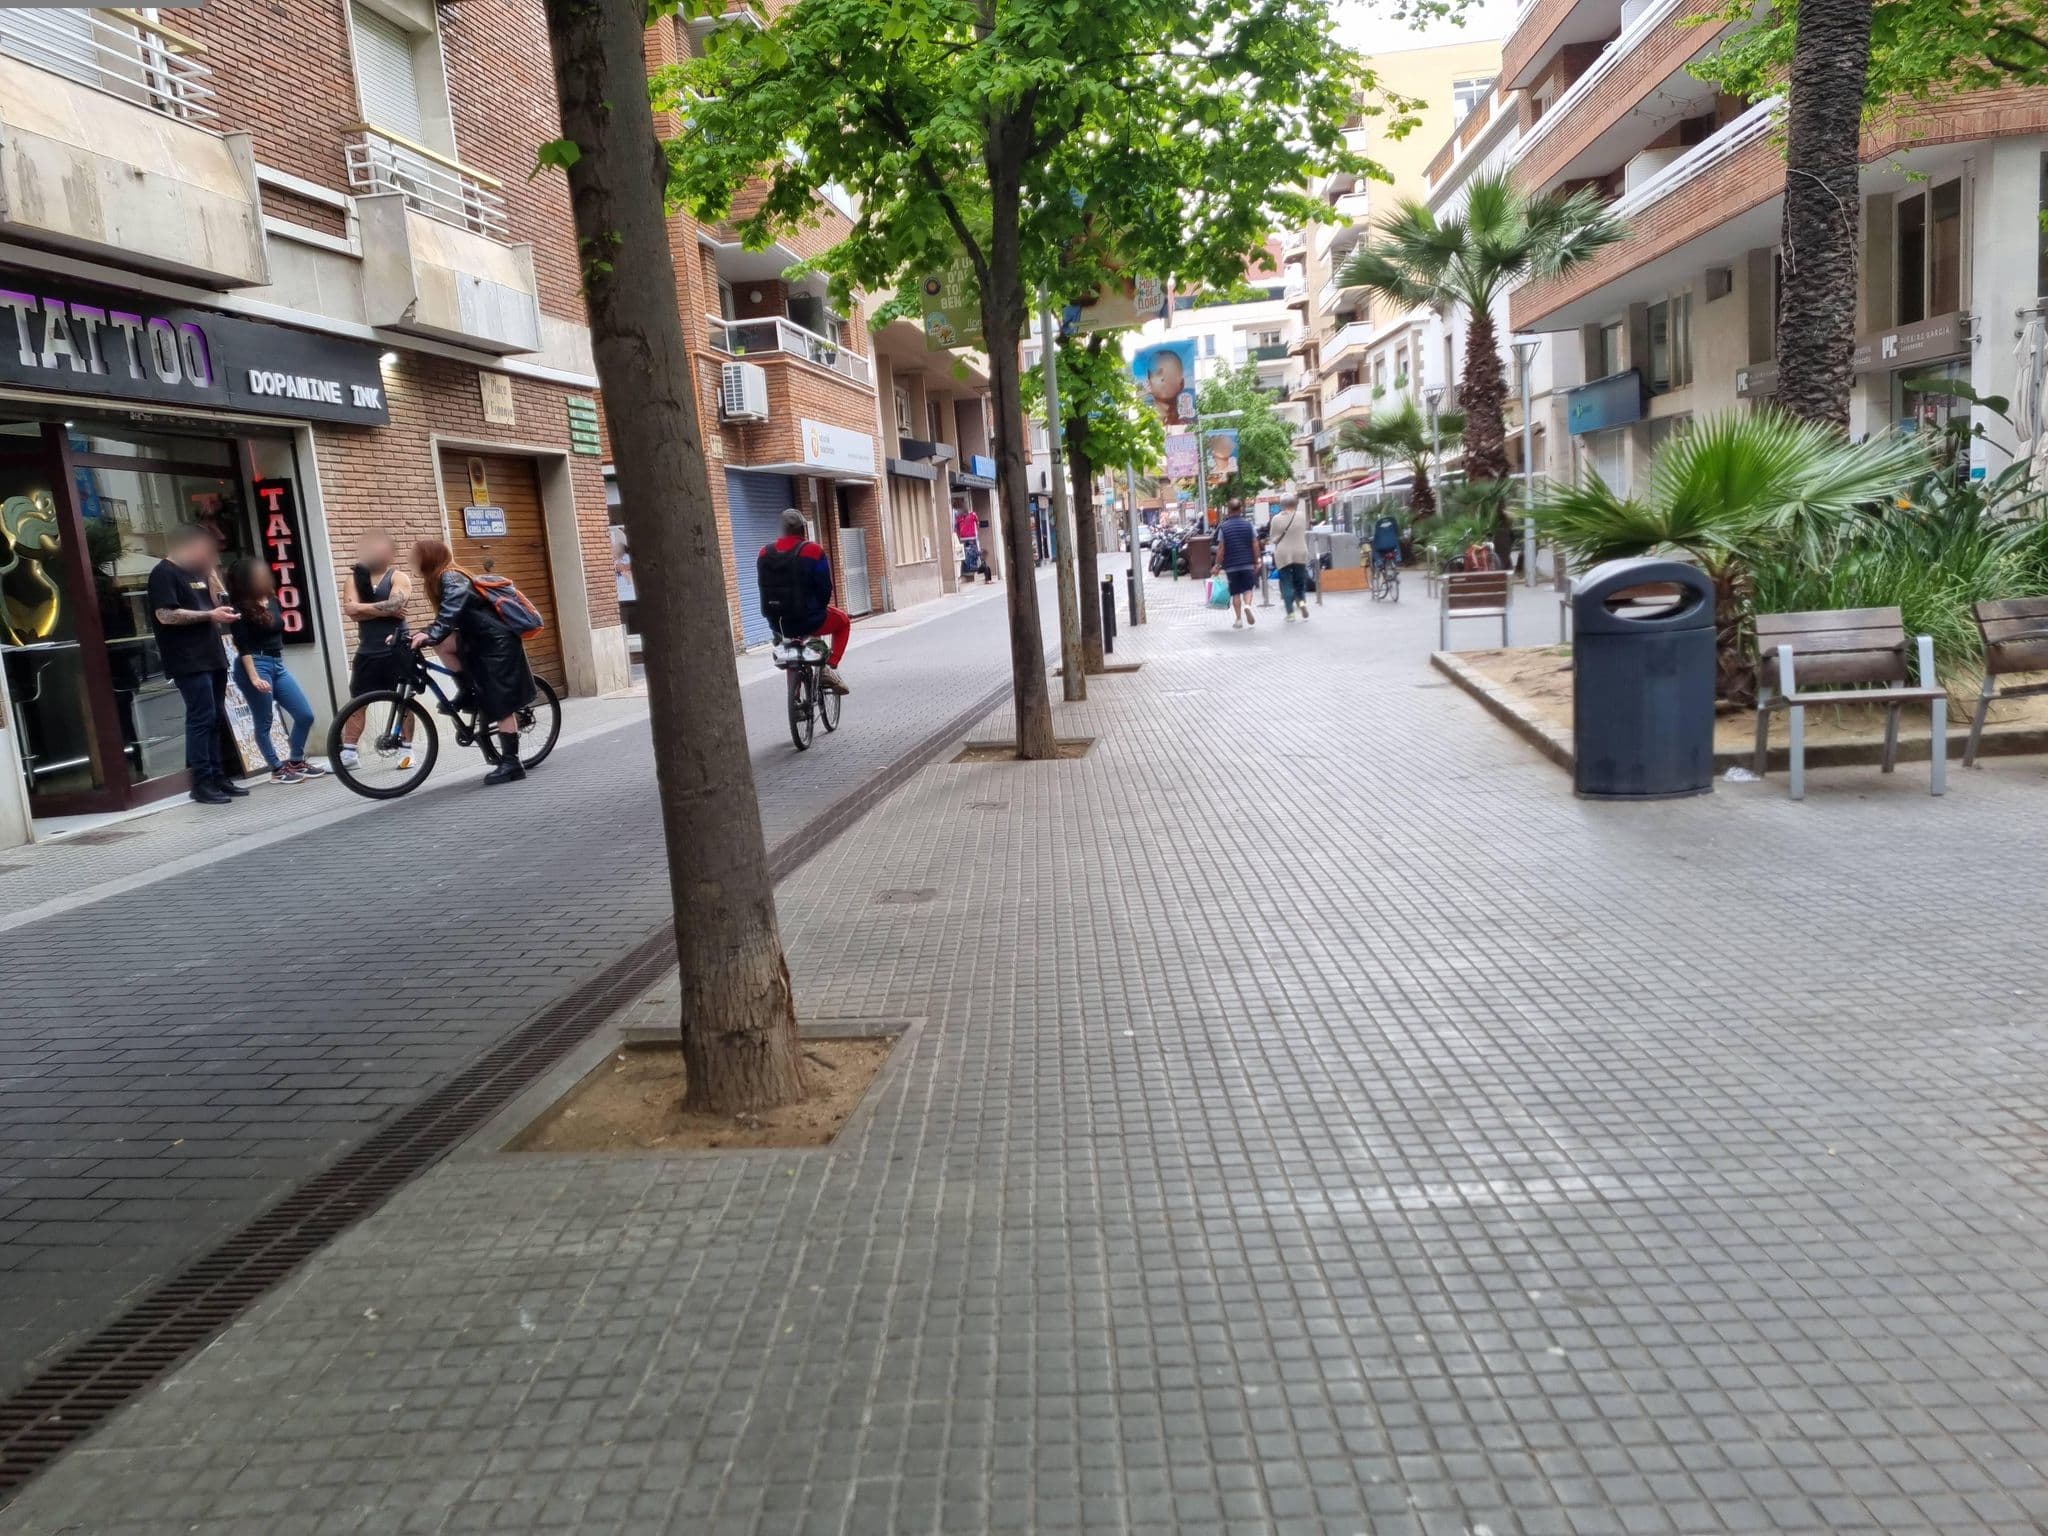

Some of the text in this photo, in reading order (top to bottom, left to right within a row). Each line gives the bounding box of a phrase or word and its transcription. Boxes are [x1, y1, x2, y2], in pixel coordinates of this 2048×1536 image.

[1138, 294, 1160, 309] LLORET
[0, 289, 213, 388] TATTOO
[249, 369, 382, 409] DOPAMINE INK
[260, 488, 302, 632] TATTOO
